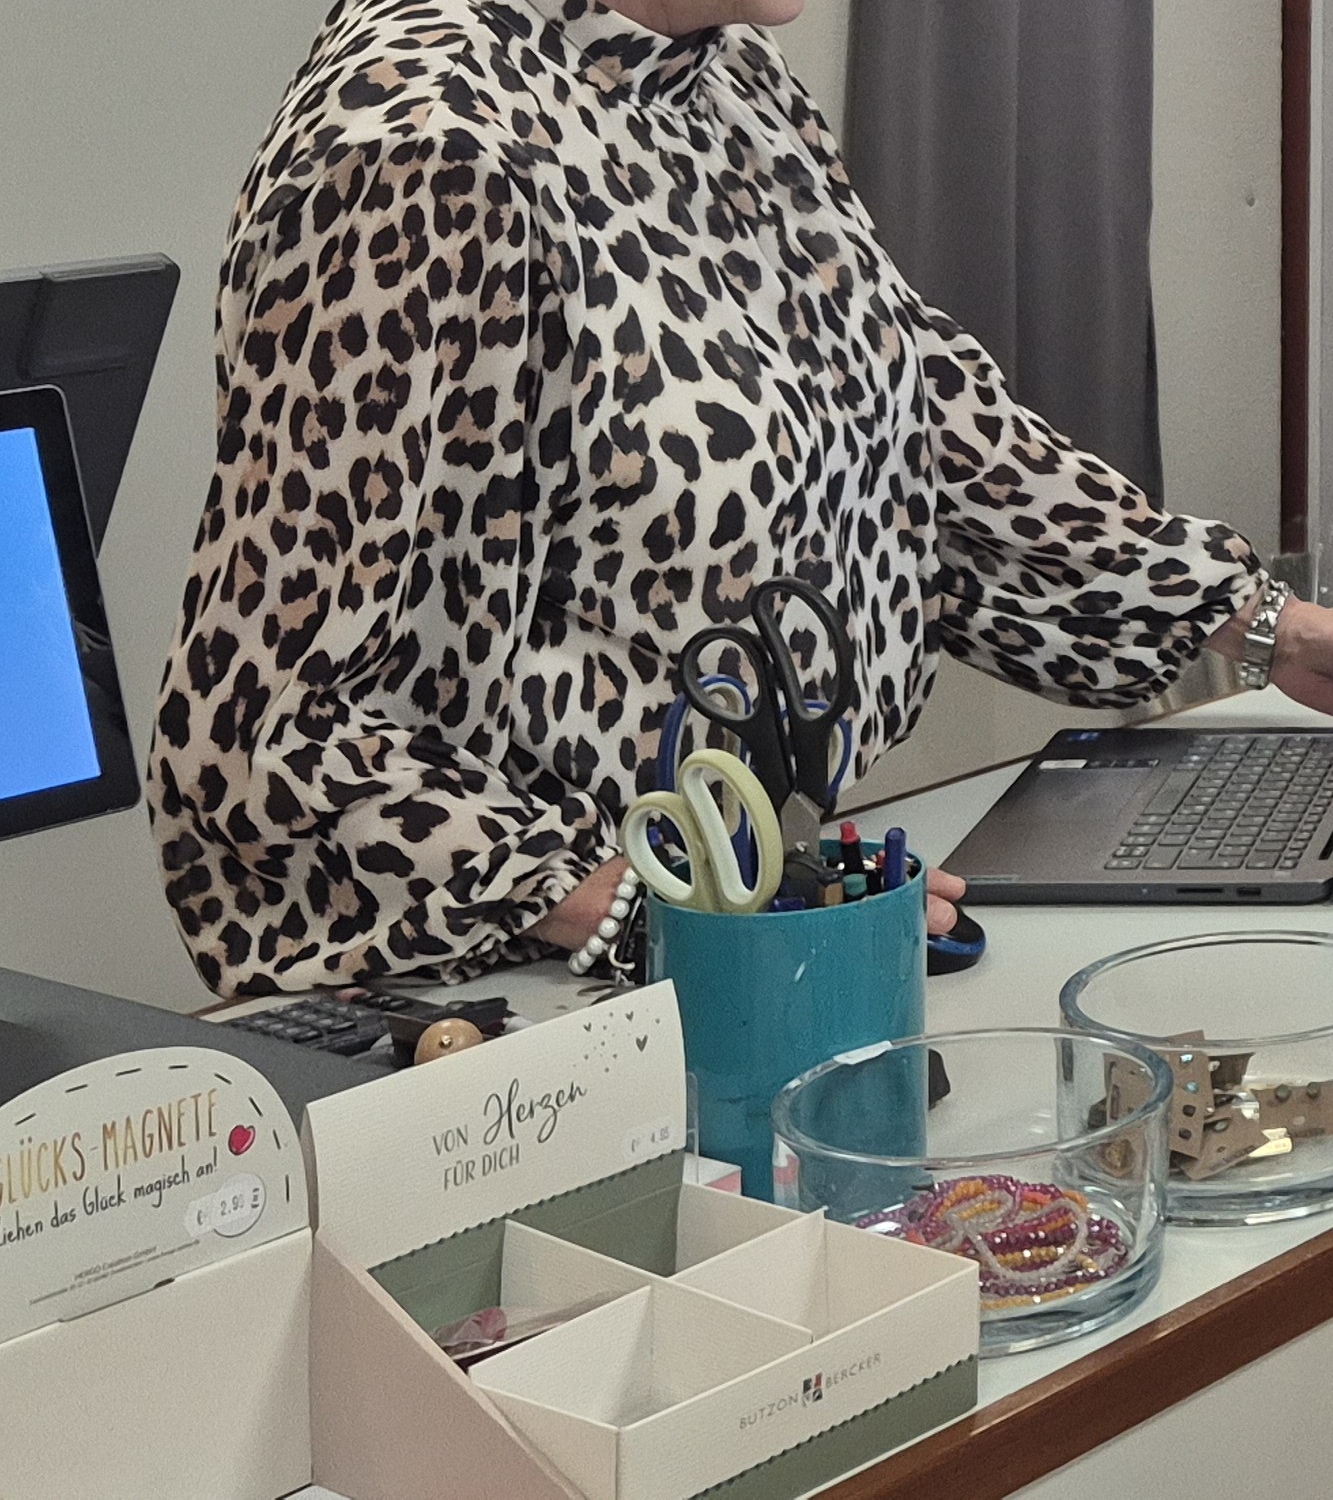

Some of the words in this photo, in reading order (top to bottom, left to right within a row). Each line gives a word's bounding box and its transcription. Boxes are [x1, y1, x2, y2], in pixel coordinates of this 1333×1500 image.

[431, 1123, 469, 1157] VON
[483, 1077, 589, 1146] Herzen
[51, 1200, 77, 1229] das
[133, 1154, 191, 1209] magisch
[195, 1146, 218, 1179] an!
[443, 1157, 476, 1192] FÜR
[481, 1143, 521, 1178] DICH
[738, 1391, 800, 1431] BUTZON
[824, 1352, 882, 1390] BERCKER
